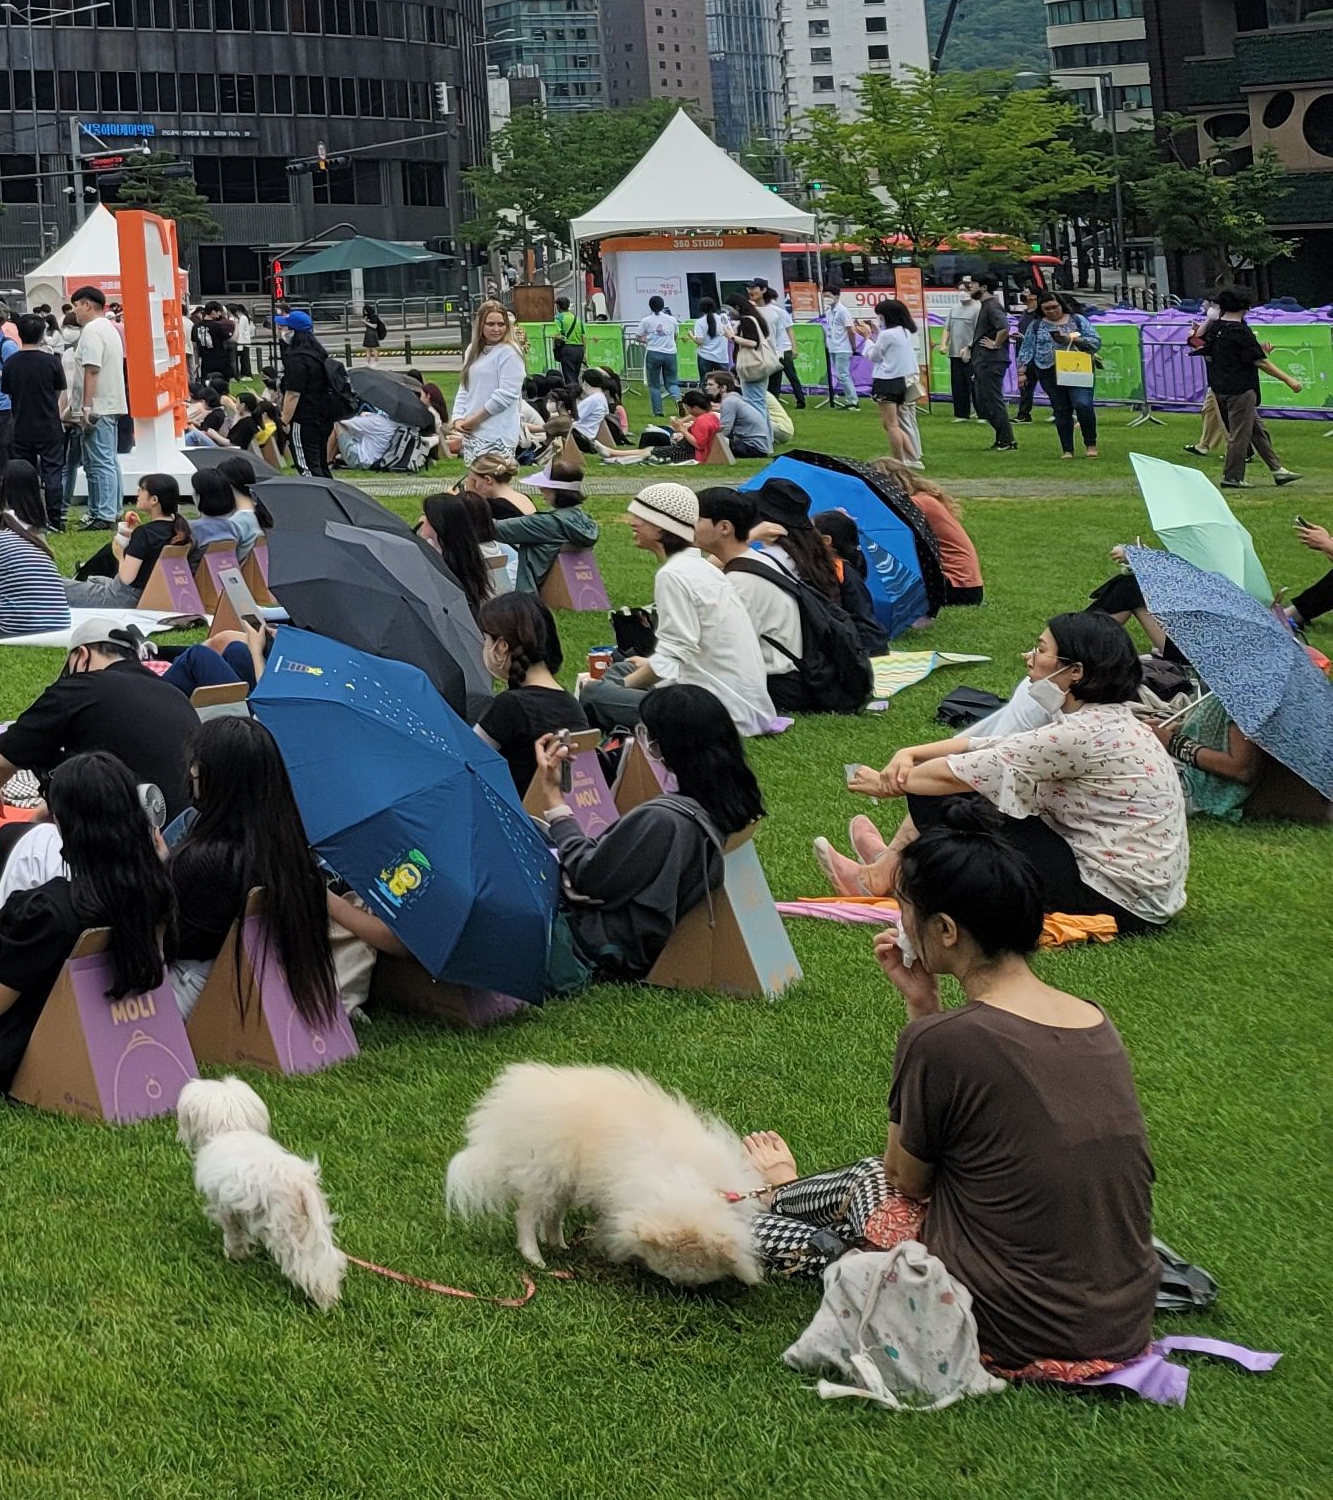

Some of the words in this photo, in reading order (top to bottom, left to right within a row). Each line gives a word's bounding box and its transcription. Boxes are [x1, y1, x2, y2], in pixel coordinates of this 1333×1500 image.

[673, 239, 690, 248] 360
[692, 238, 724, 248] STUDIO
[575, 787, 602, 810] MOLI
[110, 994, 157, 1026] MOLI
